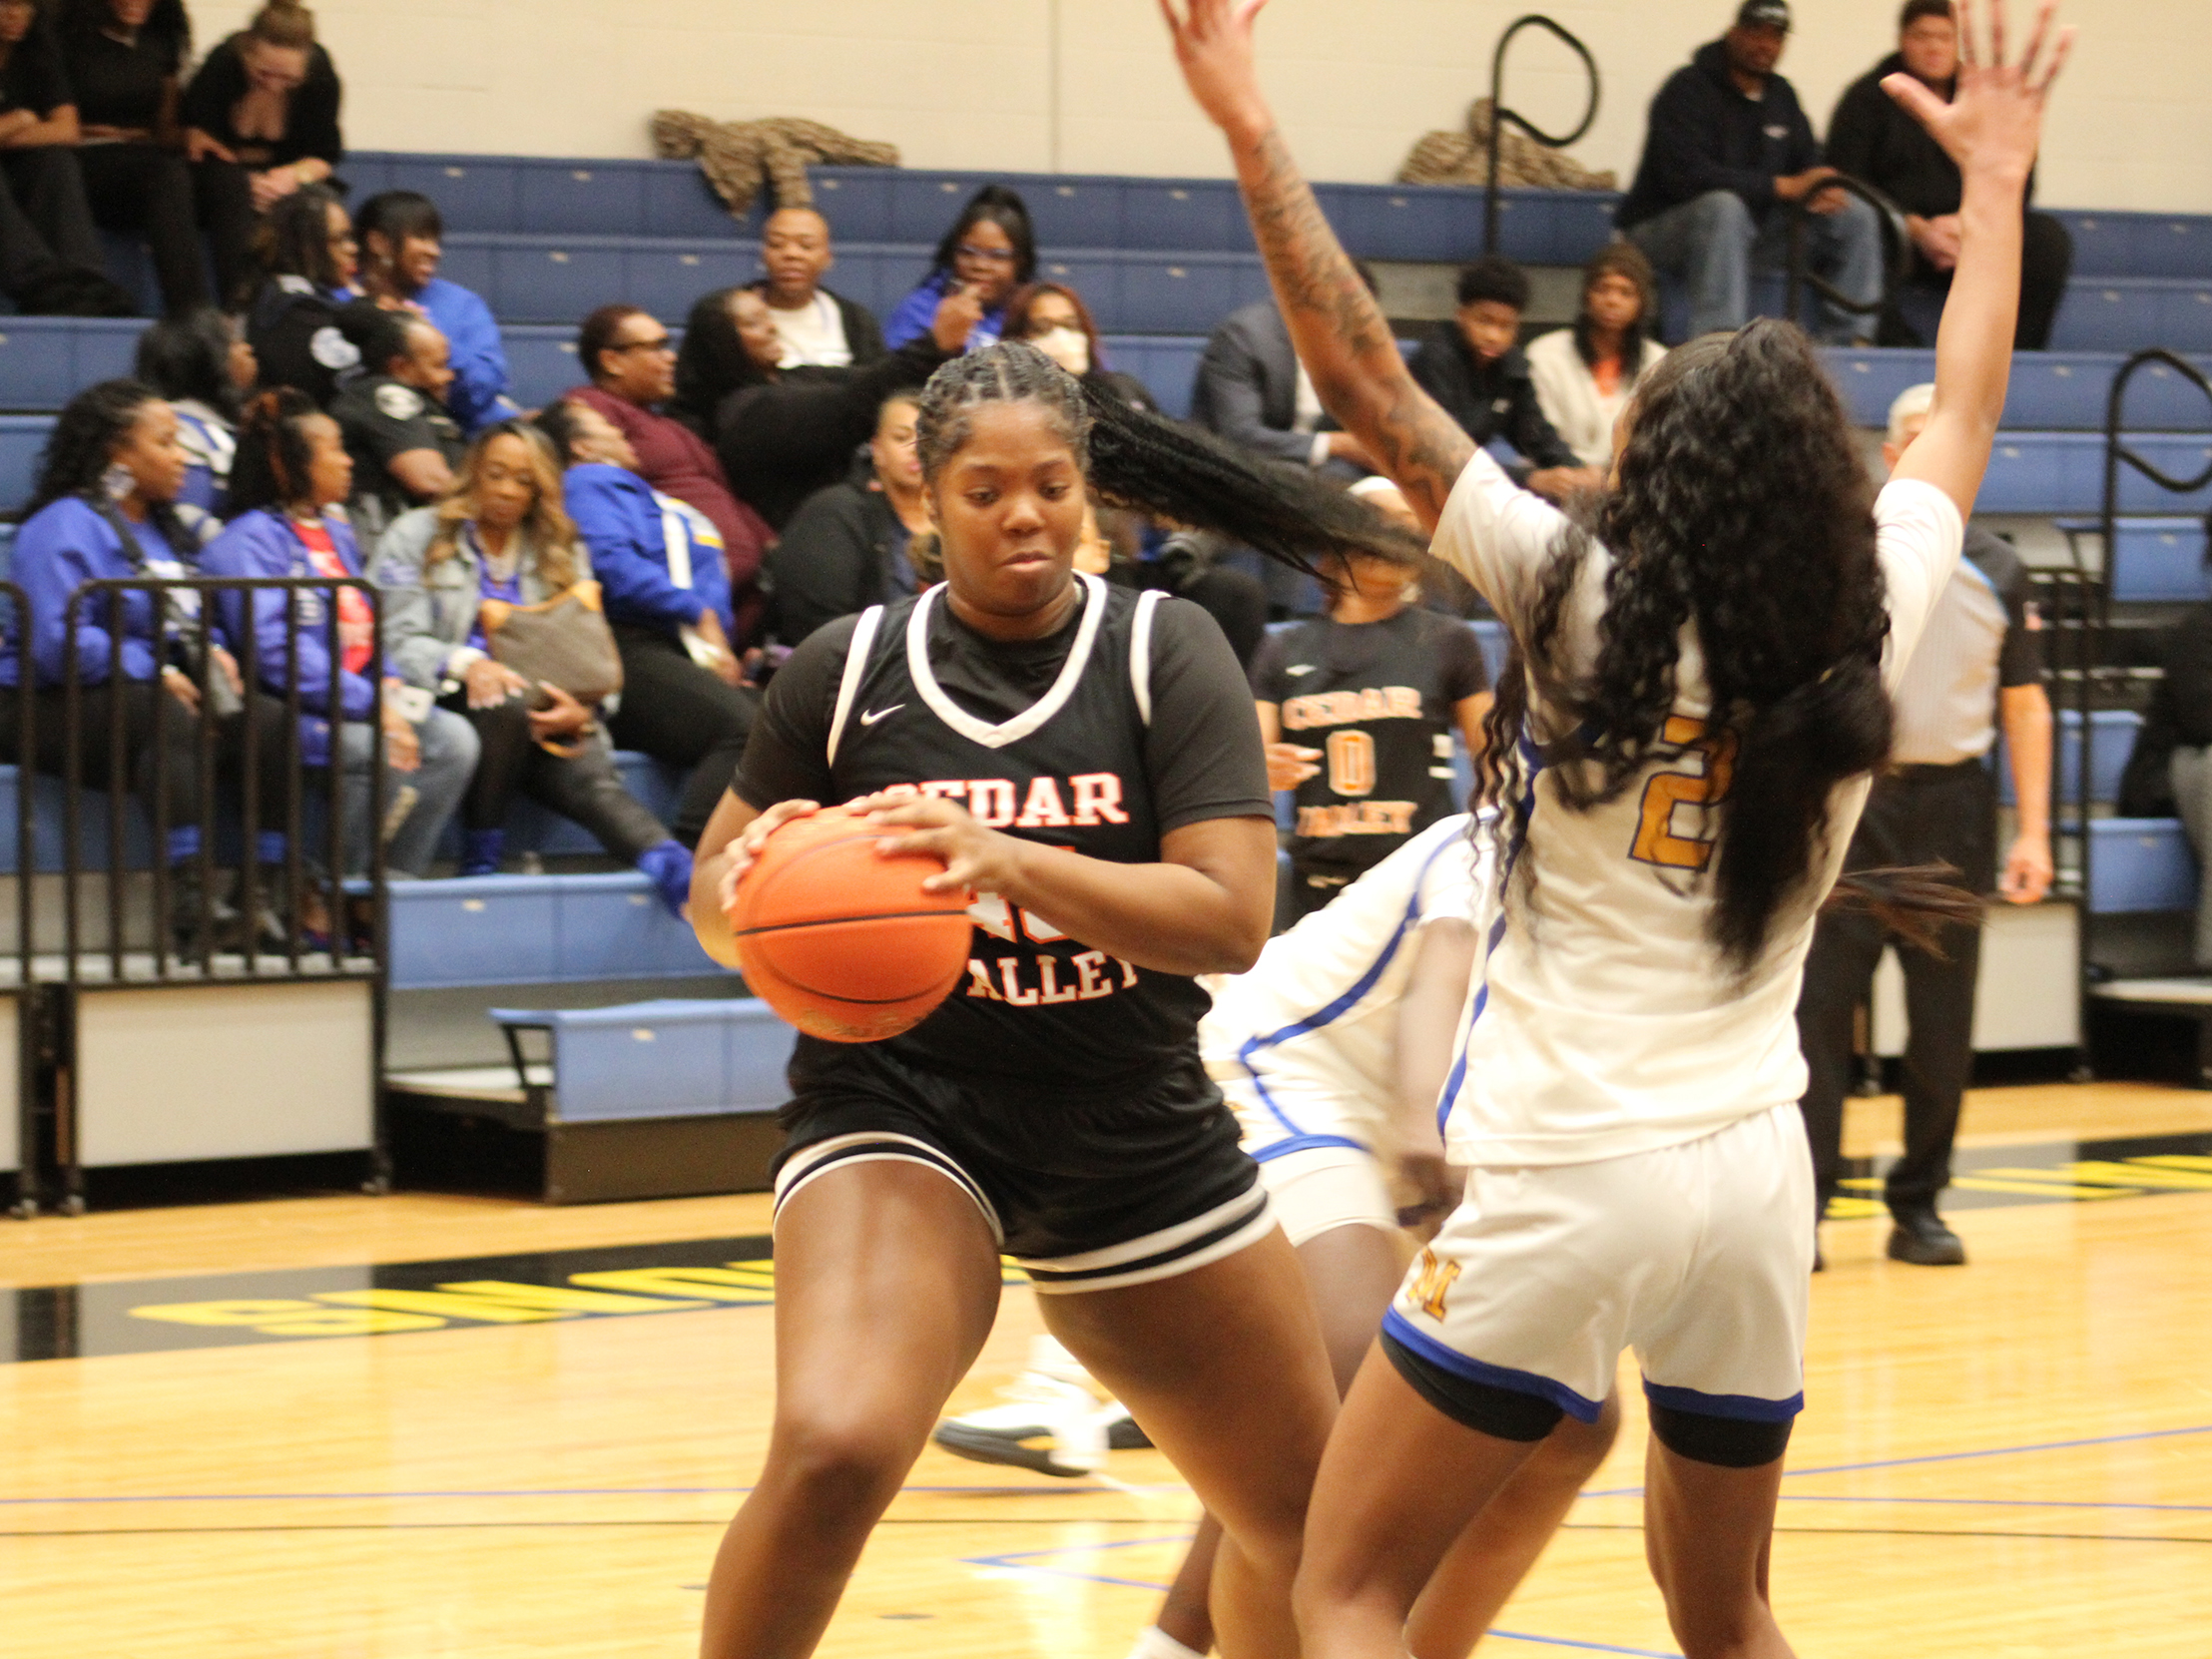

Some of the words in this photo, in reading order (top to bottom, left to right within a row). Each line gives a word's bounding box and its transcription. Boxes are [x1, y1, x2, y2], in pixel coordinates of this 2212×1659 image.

[1327, 729, 1377, 797] 0
[1628, 713, 1740, 874] 2
[882, 772, 1130, 828] DAR
[966, 950, 1139, 1007] ALLE
